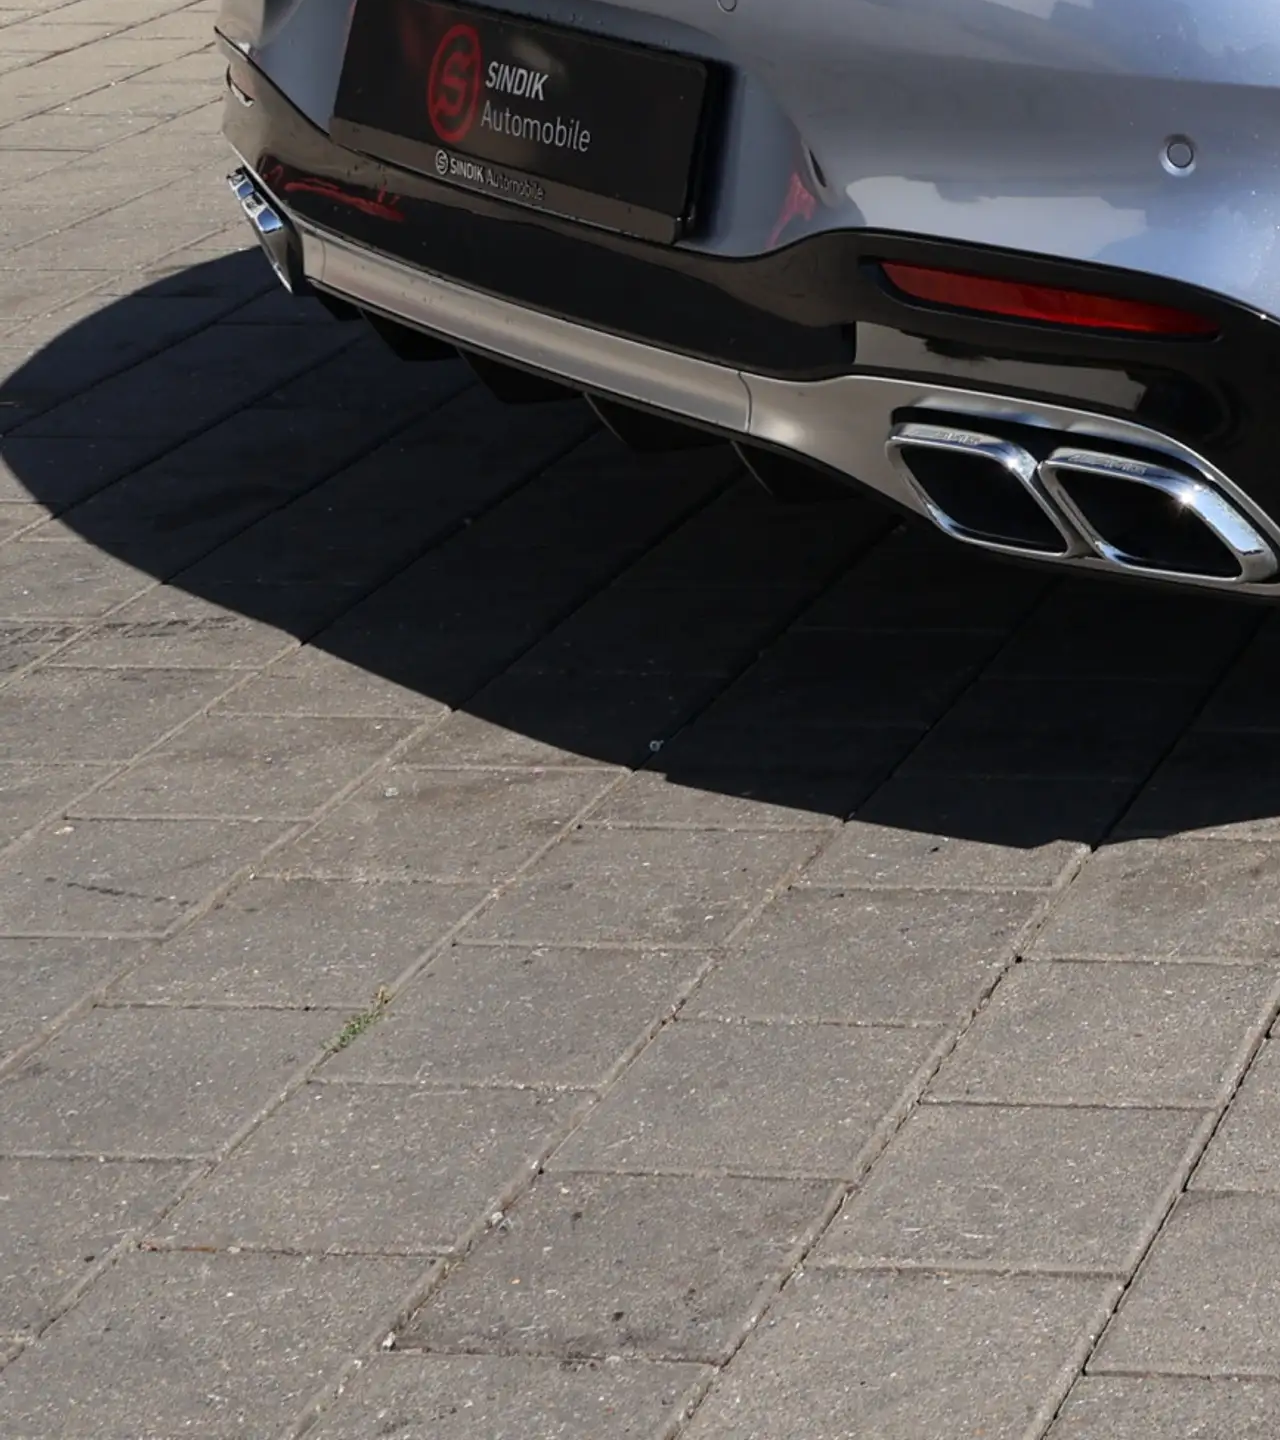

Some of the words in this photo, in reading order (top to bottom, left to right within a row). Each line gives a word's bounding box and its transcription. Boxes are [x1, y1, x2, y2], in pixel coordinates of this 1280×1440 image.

[486, 61, 549, 101] SINDIK
[481, 99, 592, 153] Automobile
[450, 157, 484, 183] SINDIK
[486, 169, 545, 201] Automobile
